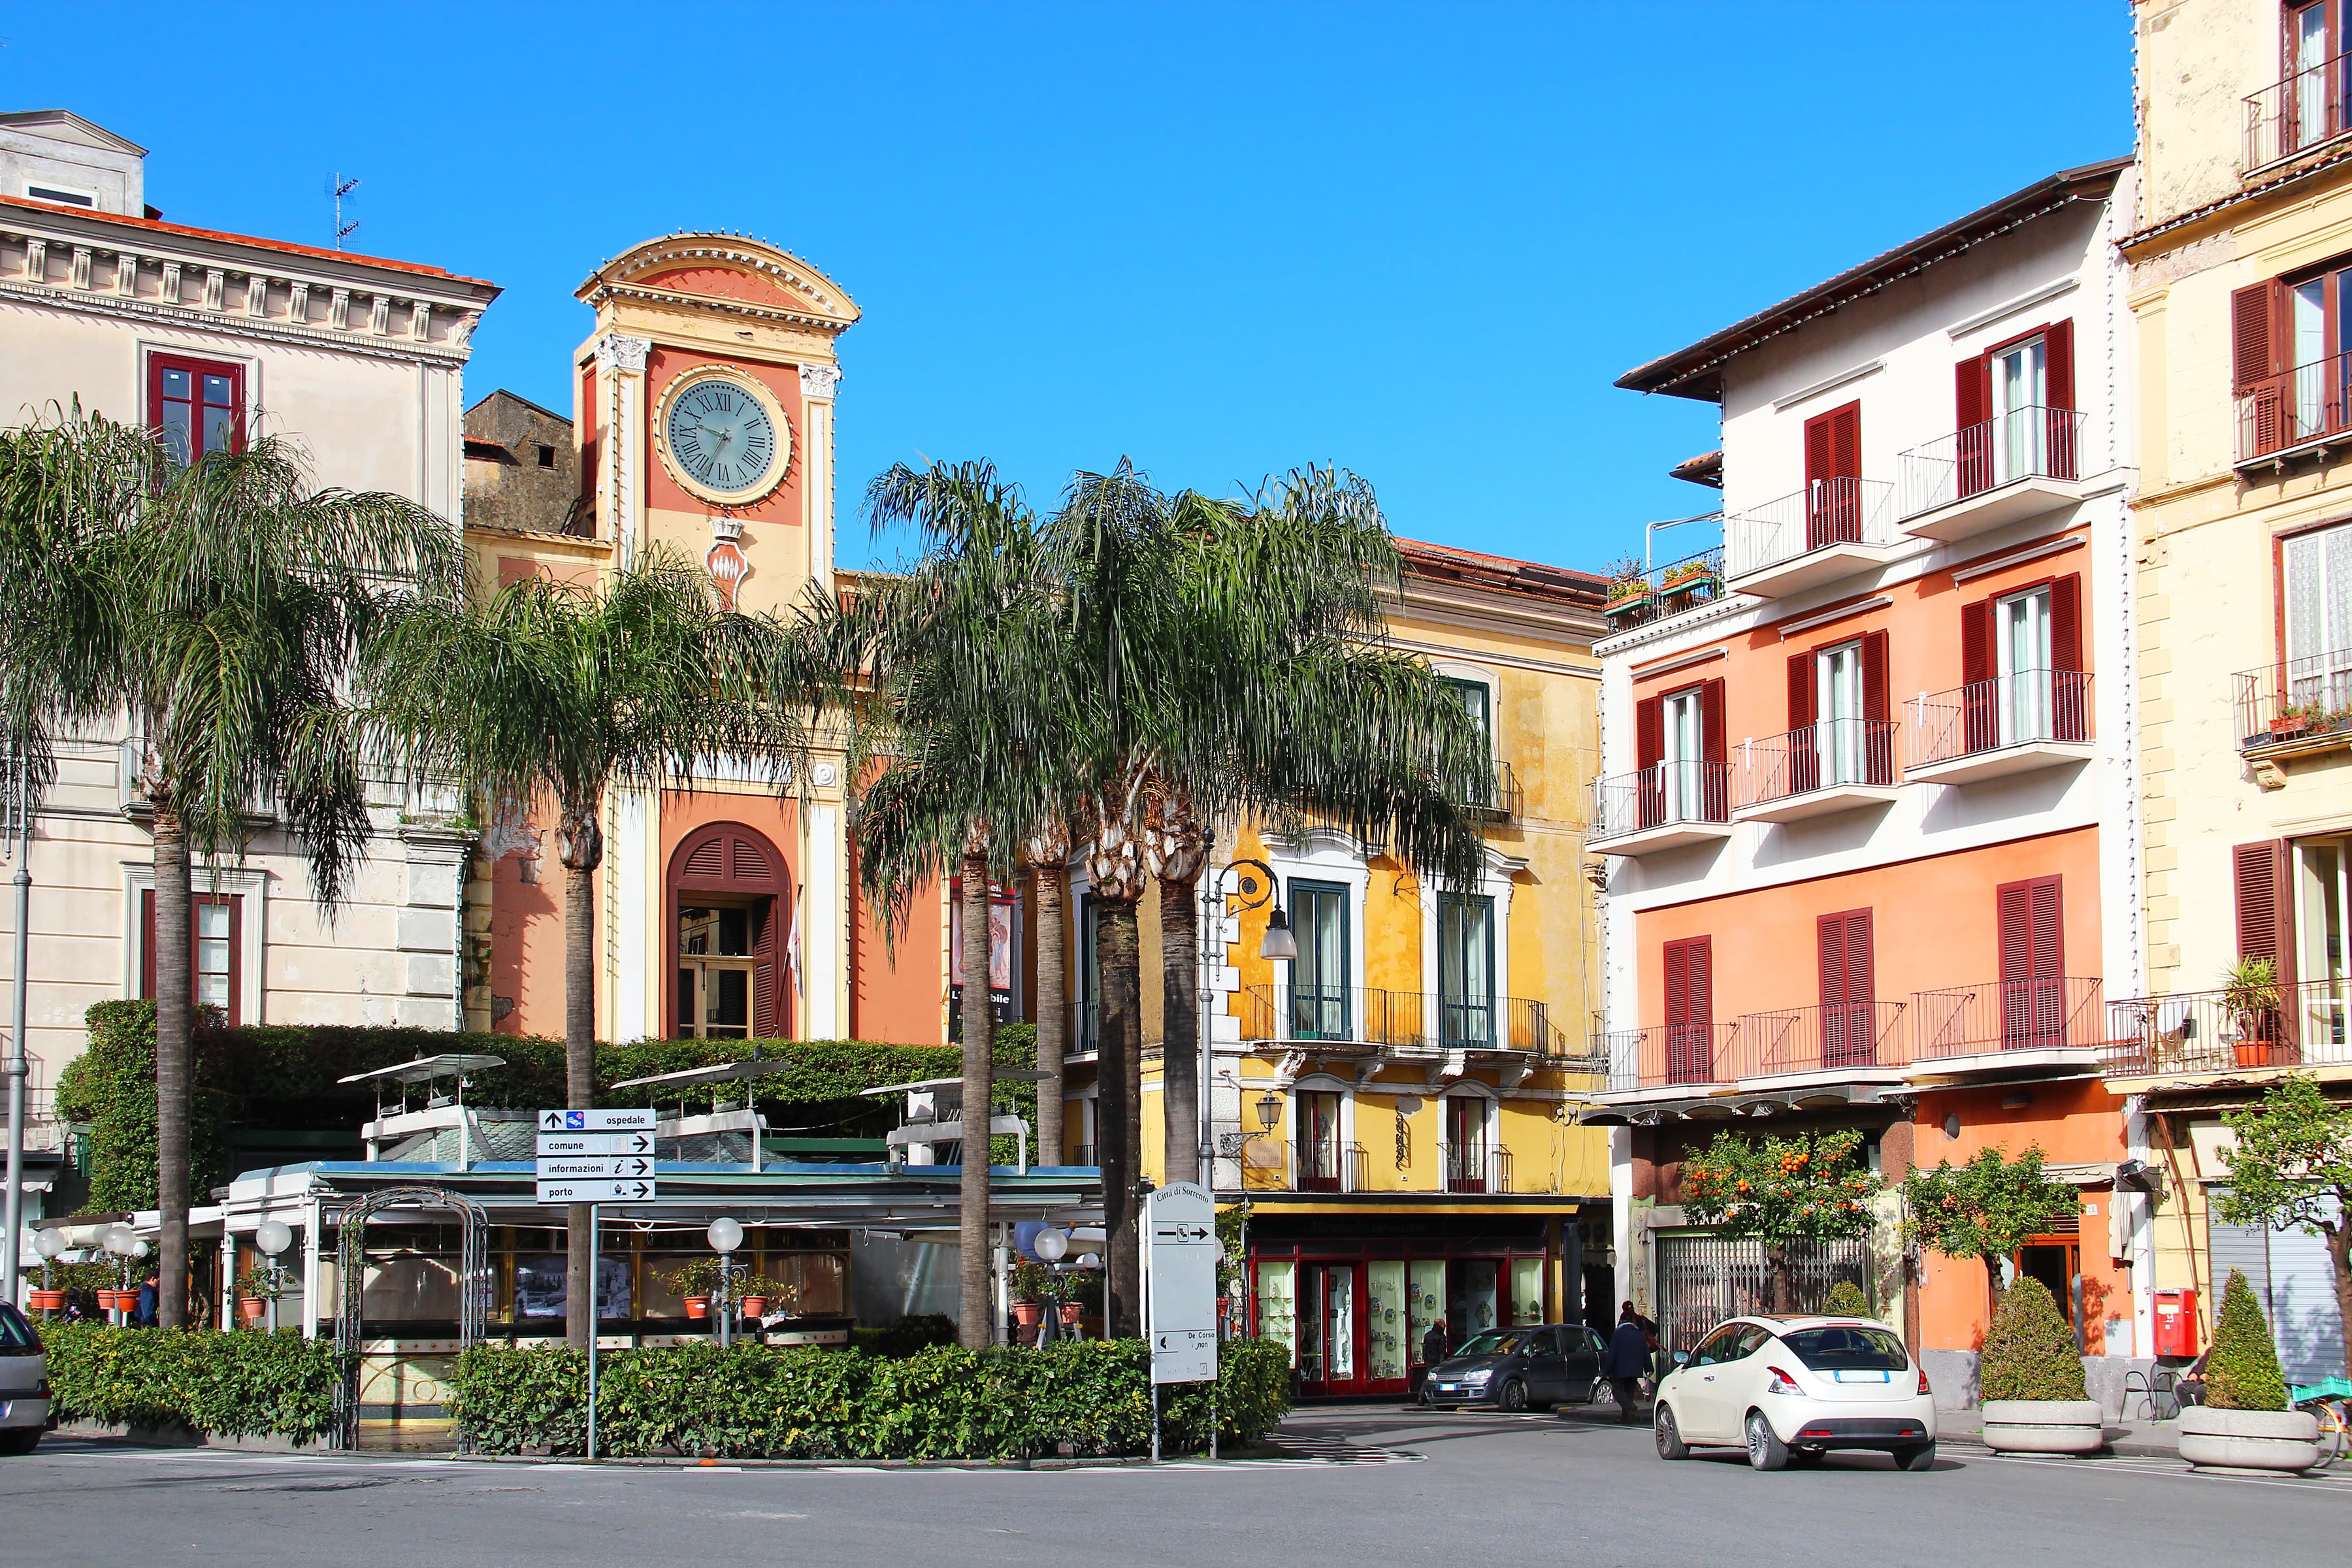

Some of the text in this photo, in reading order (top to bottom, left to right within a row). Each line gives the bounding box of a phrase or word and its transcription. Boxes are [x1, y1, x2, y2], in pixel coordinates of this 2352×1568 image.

[696, 394, 713, 414] XI
[715, 393, 731, 412] XII
[683, 406, 702, 423] X
[679, 425, 696, 438] IX
[743, 418, 761, 431] II
[748, 436, 765, 449] III
[681, 440, 704, 463] VIII
[717, 463, 730, 482] VI
[736, 463, 747, 480] V
[606, 1115, 645, 1126] ospedale
[549, 1164, 604, 1173] informazioni
[549, 1188, 573, 1198] porto
[1174, 1186, 1181, 1195] di
[1182, 1186, 1209, 1203] Sorrento
